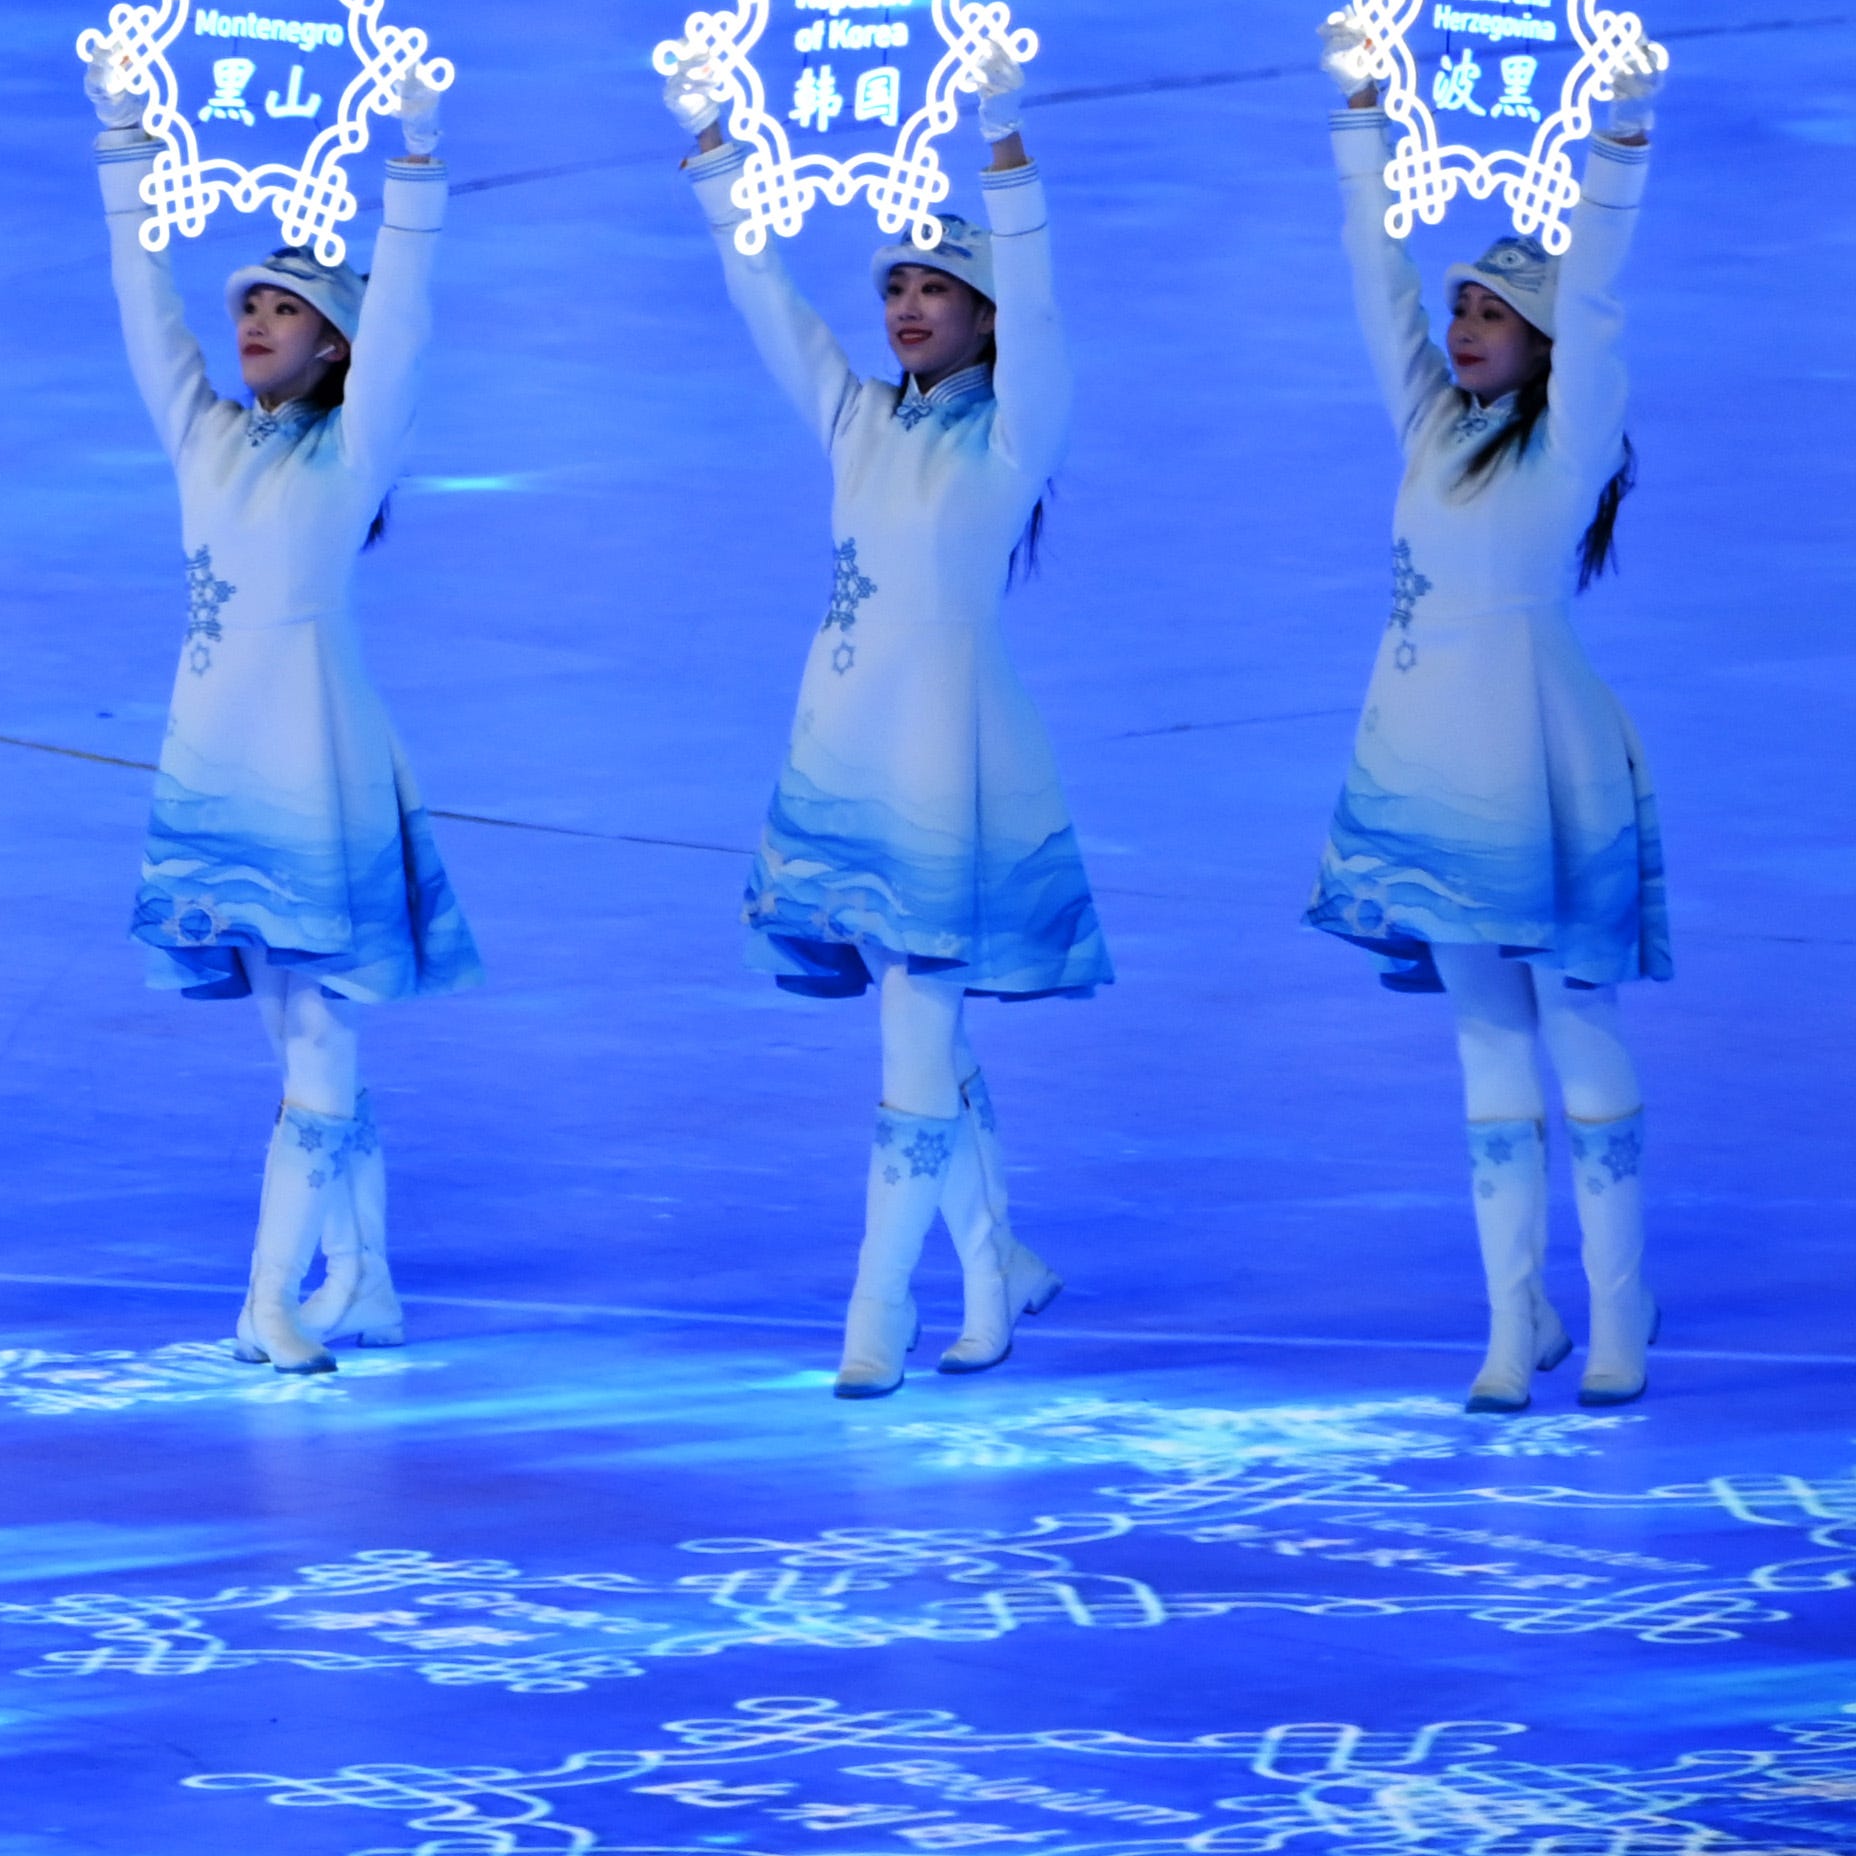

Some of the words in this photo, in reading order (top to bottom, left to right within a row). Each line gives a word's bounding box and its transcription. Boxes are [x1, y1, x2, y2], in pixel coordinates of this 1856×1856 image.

[194, 8, 345, 53] Montenegro
[794, 19, 826, 52] of
[828, 18, 909, 50] Korea
[1434, 4, 1557, 42] Herzegovina
[198, 58, 322, 127] 黑山
[789, 64, 901, 133] 韩国
[1433, 48, 1541, 123] 波黑
